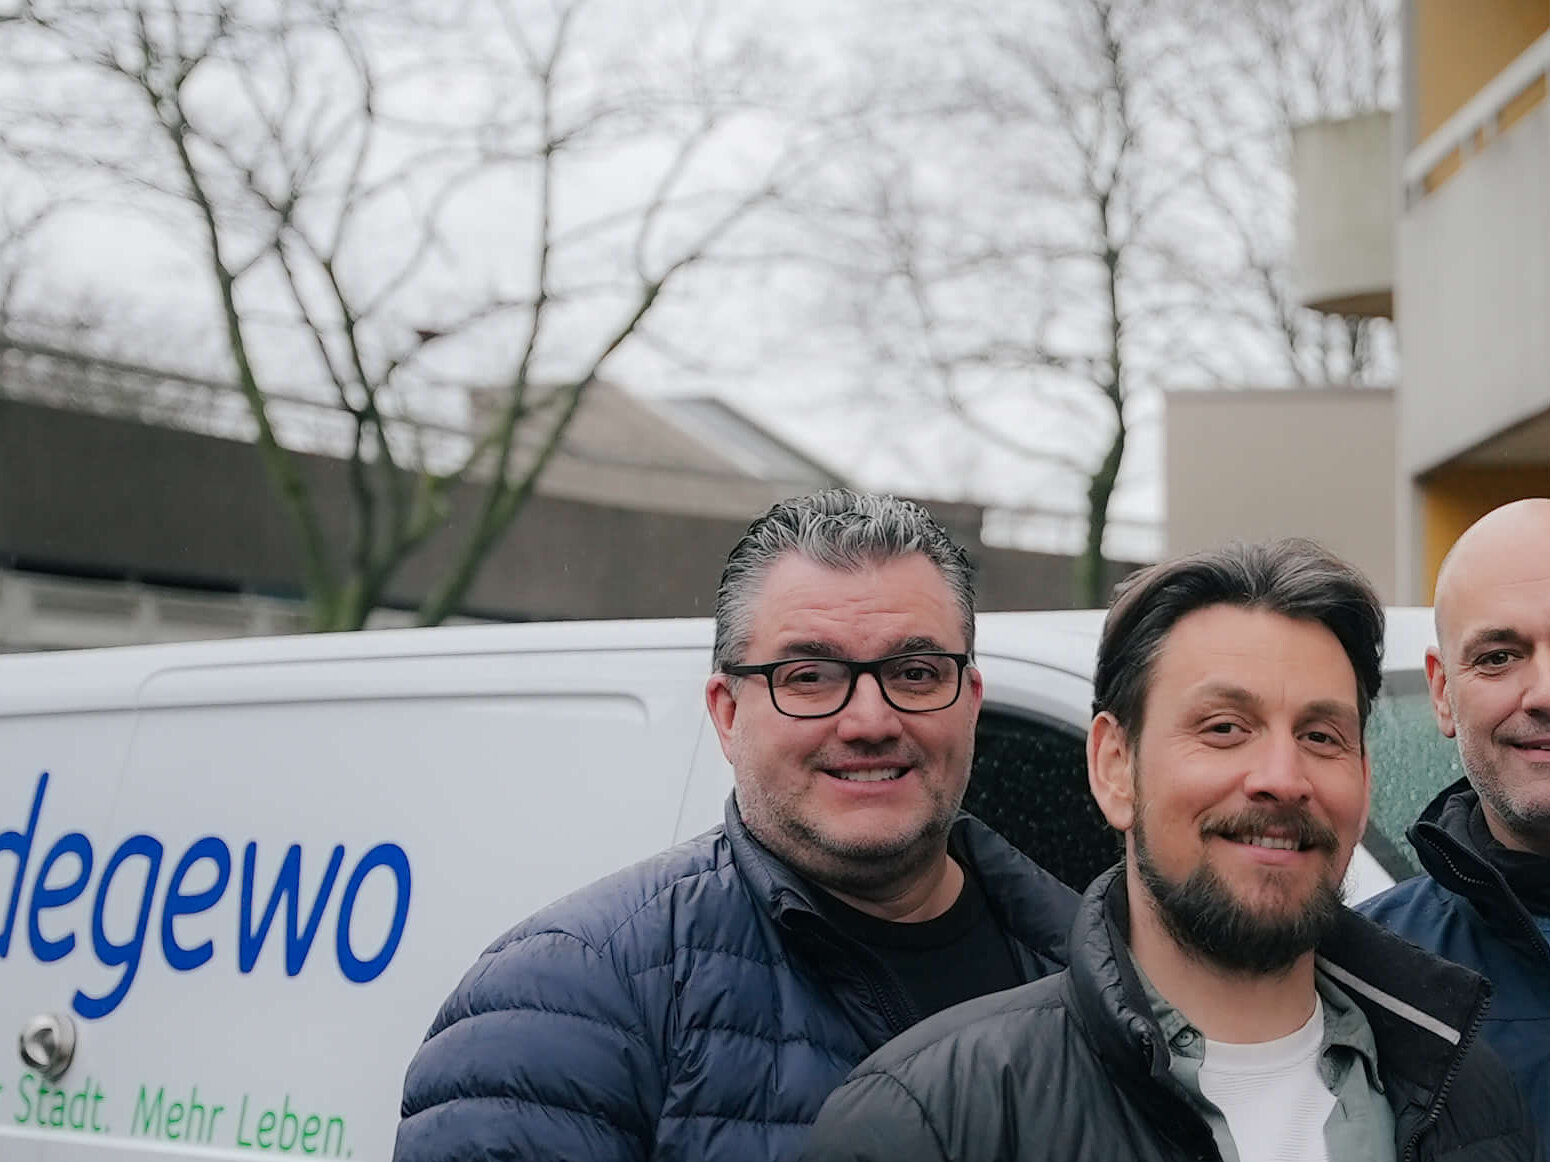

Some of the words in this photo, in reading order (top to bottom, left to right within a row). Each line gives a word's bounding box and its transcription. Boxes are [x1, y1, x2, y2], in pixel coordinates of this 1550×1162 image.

[0, 772, 412, 1020] degewo
[13, 1072, 111, 1134] Stadt.
[130, 1083, 225, 1145] Mehr
[236, 1093, 353, 1160] Leben.
